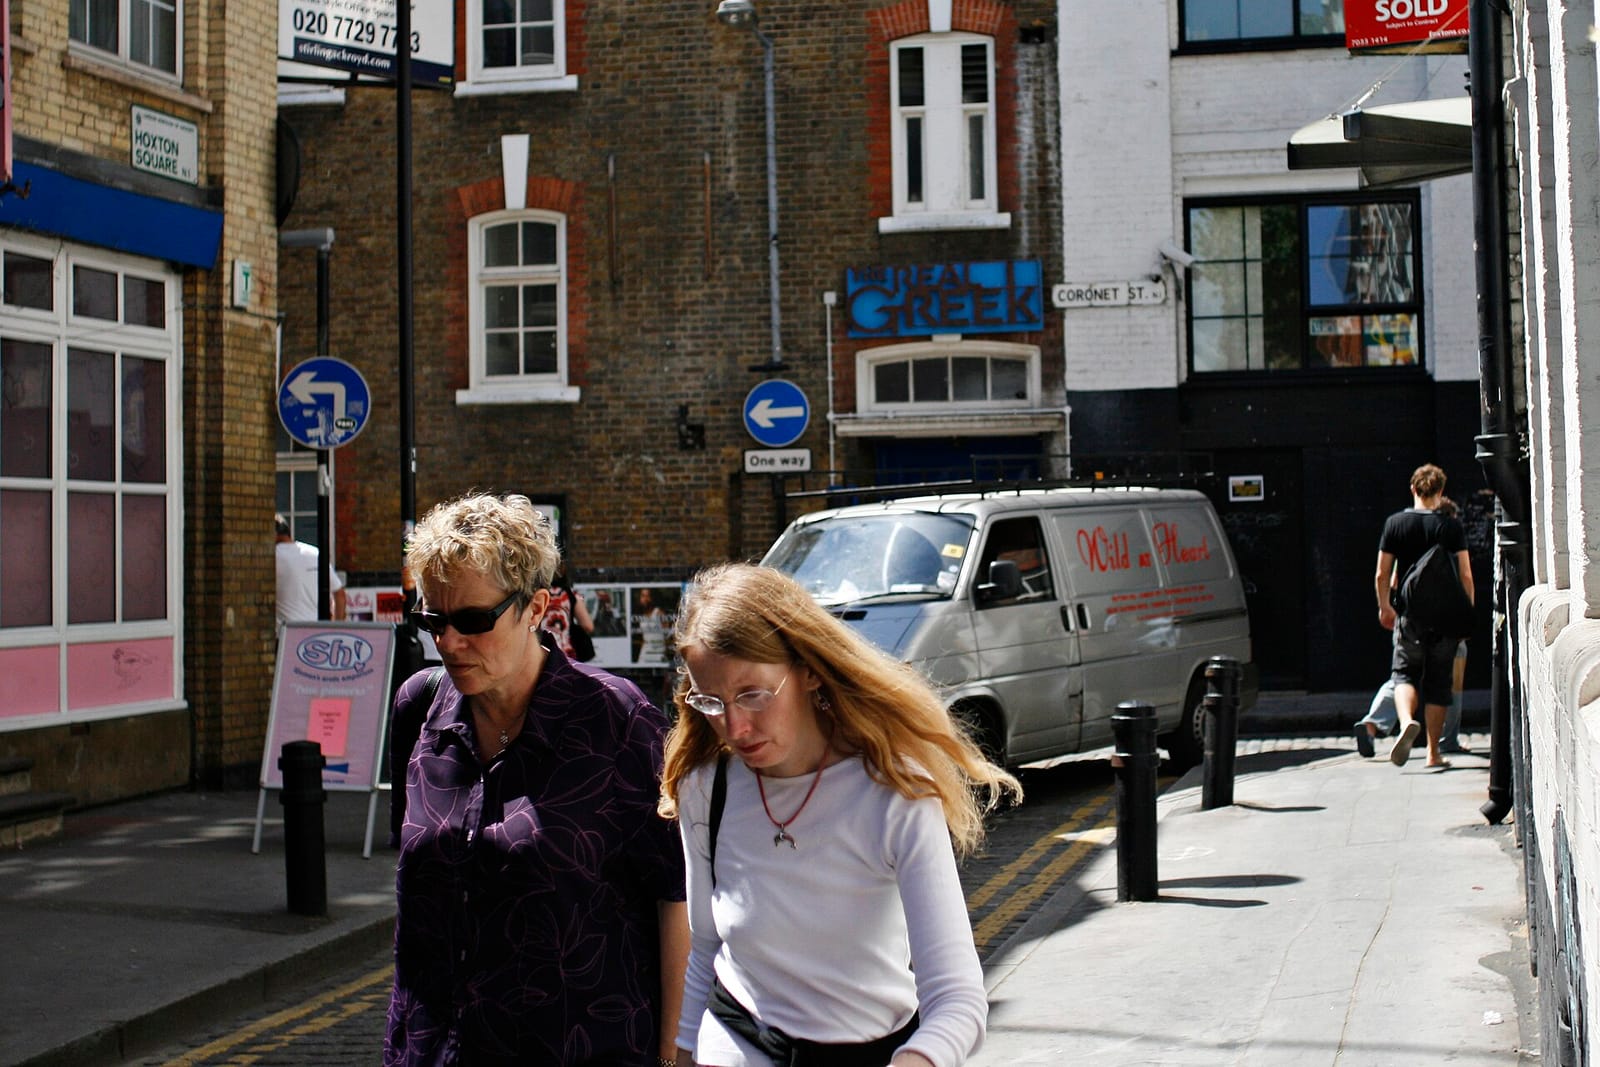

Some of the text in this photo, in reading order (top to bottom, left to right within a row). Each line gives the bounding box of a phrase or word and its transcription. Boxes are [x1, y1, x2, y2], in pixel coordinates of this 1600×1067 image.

[1375, 0, 1448, 22] SOLD
[293, 8, 420, 53] 020 7729 773
[298, 43, 392, 69] stirlingackroyd.com
[134, 127, 179, 157] HOXTON
[135, 148, 192, 177] SQUARE N1
[893, 260, 983, 294] REAL
[848, 262, 1041, 336] GREEK
[1057, 287, 1120, 303] CORONET
[1128, 286, 1149, 301] ST.
[749, 455, 806, 468] One way
[1076, 526, 1132, 573] Wild
[1152, 522, 1212, 566] Heart
